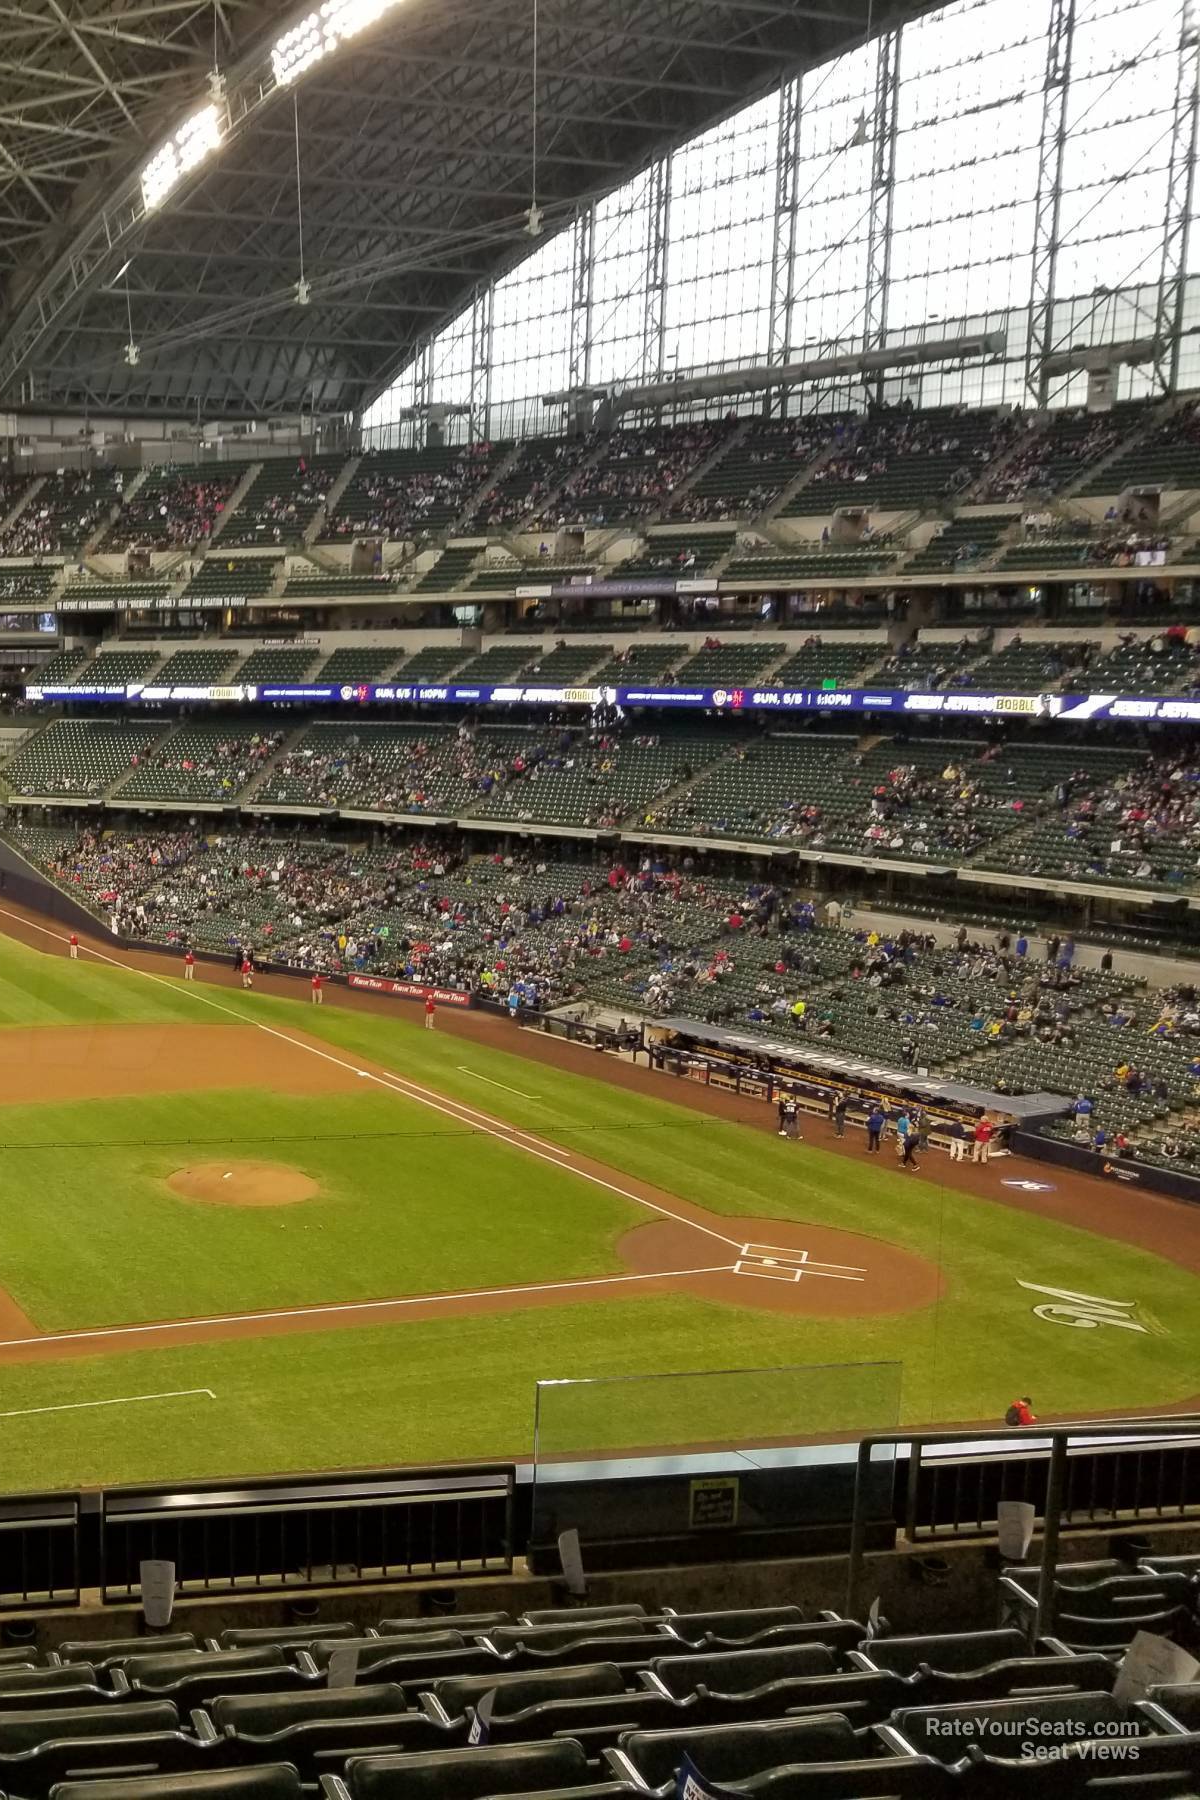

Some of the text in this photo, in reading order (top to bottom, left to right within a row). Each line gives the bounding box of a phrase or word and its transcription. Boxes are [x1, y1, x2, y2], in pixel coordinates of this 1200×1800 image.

[996, 697, 1035, 711] BOBBLE
[353, 976, 382, 988] KWIK TRIP
[392, 983, 423, 995] KWIK TRIP
[433, 990, 465, 1002] KWIK TRIP
